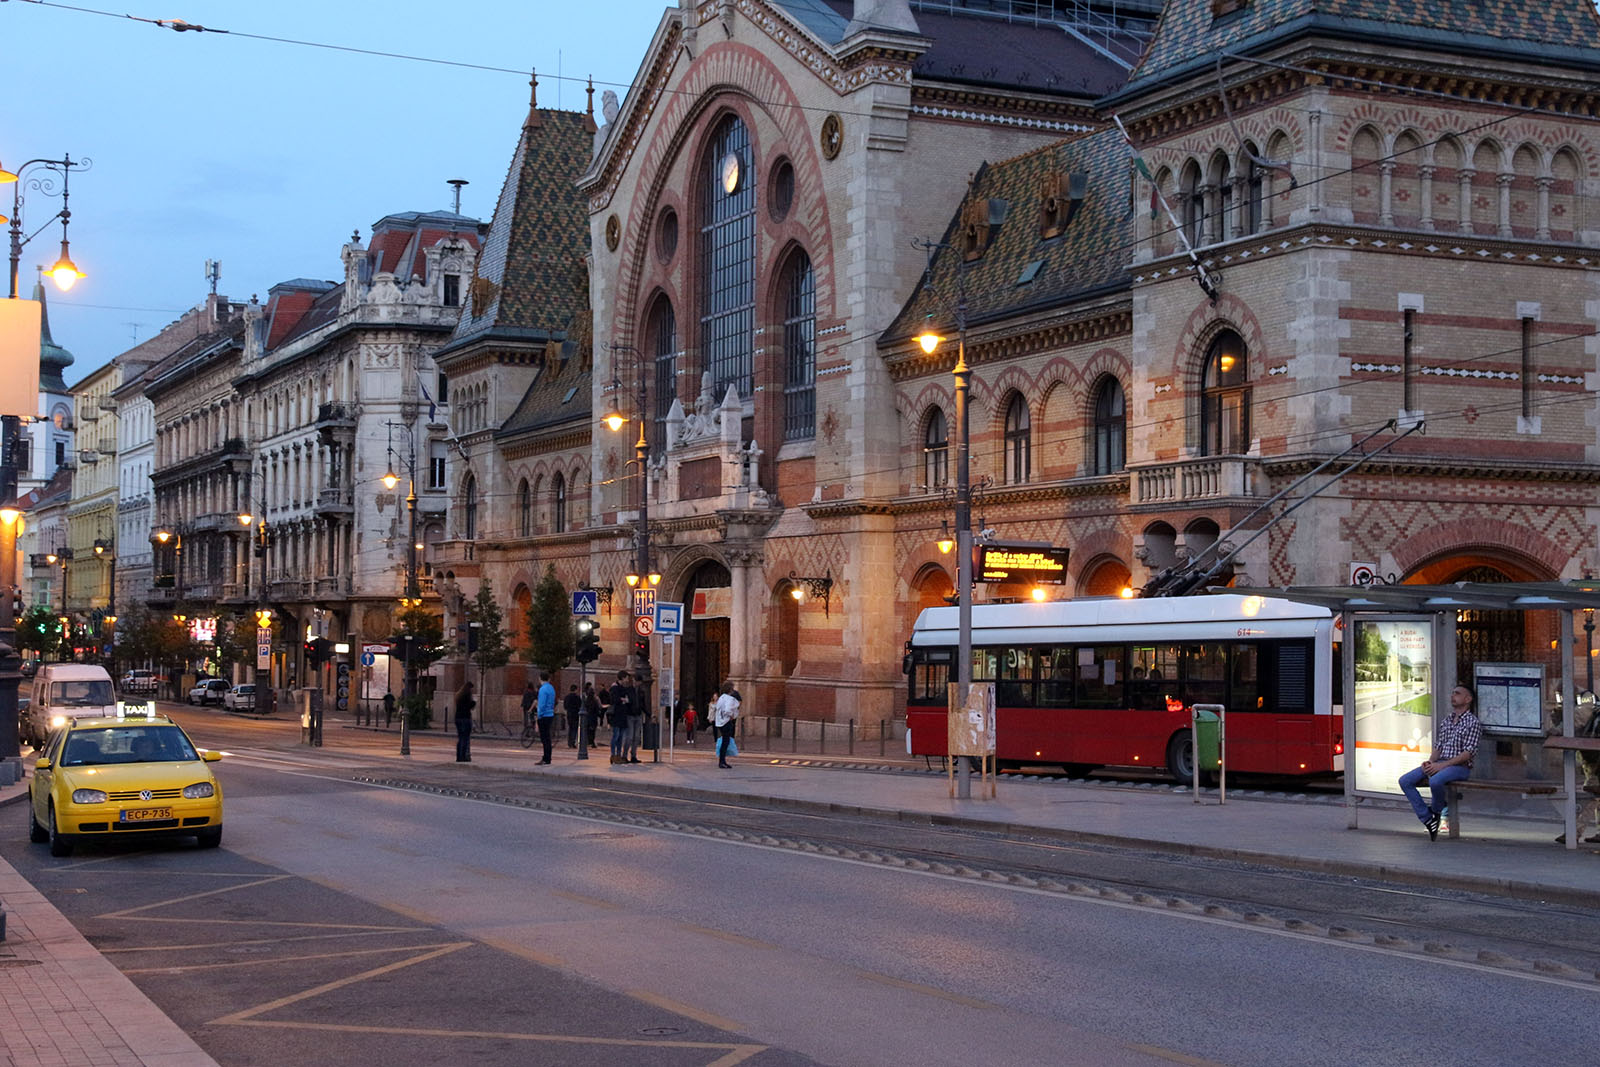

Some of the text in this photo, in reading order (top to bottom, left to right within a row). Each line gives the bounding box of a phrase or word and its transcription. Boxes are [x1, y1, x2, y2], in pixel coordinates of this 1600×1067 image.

[1237, 627, 1251, 636] 614
[260, 647, 267, 655] P
[124, 705, 148, 714] TAXI
[127, 808, 171, 820] ECP-735
